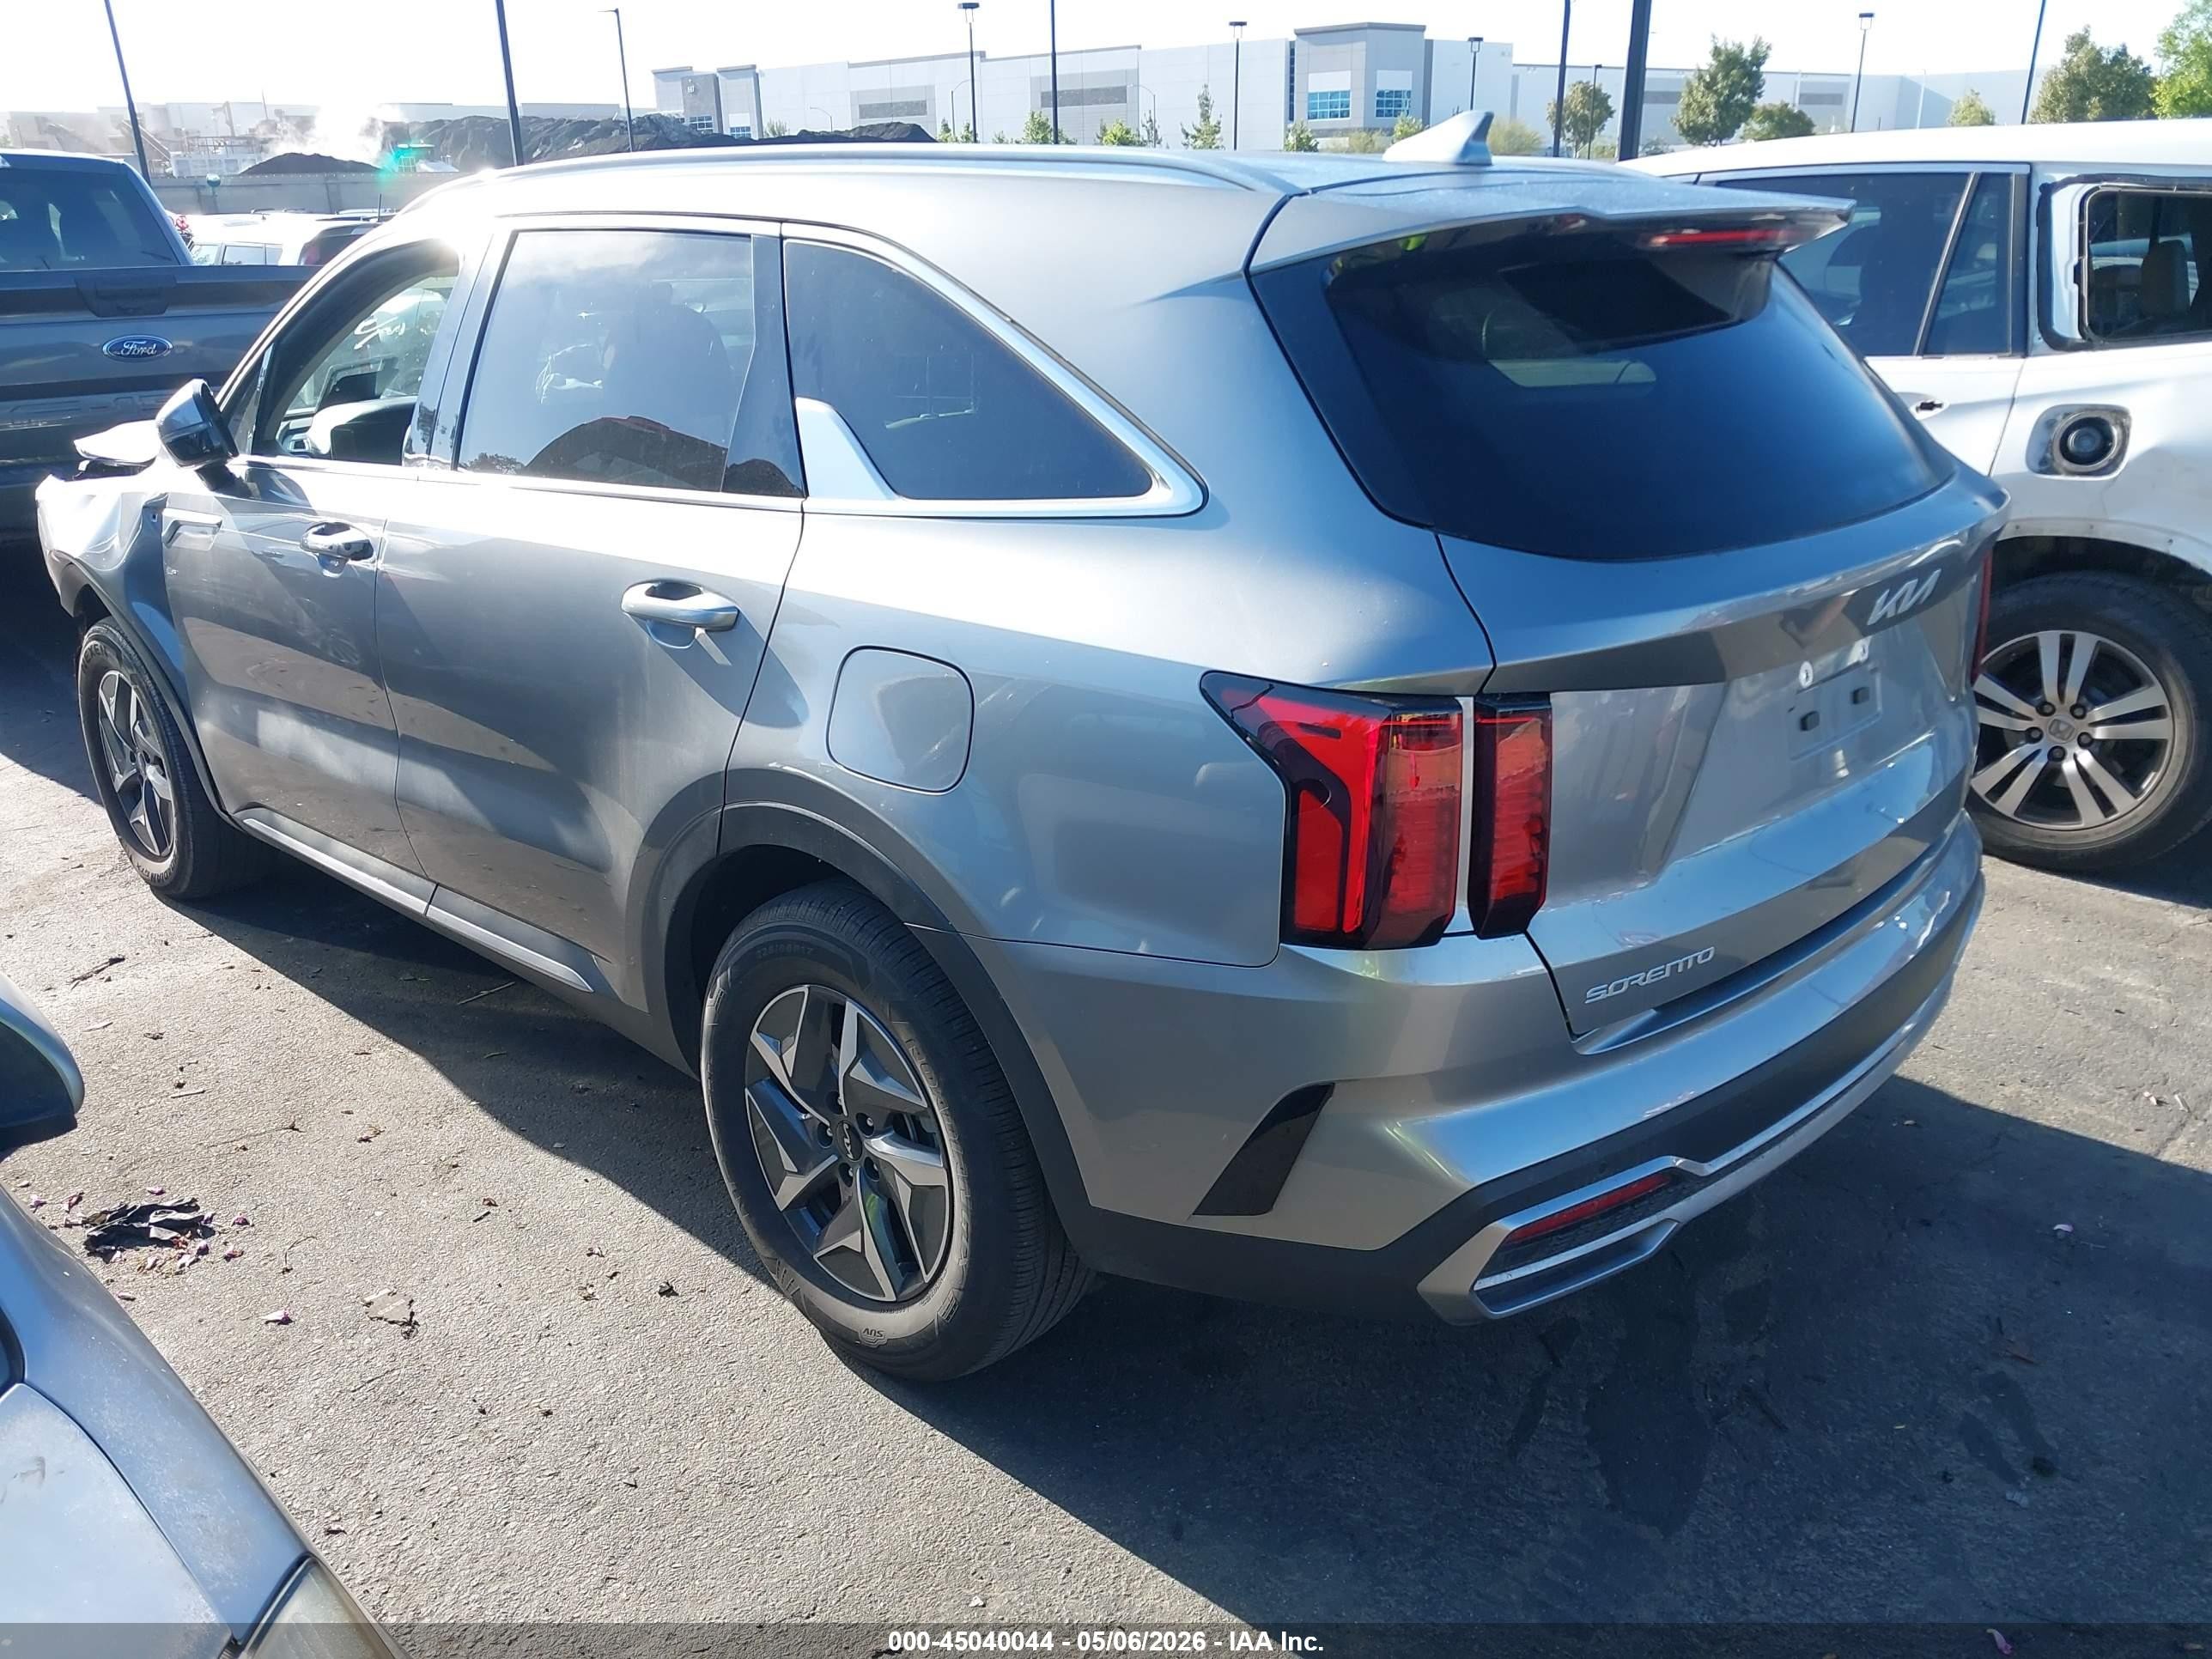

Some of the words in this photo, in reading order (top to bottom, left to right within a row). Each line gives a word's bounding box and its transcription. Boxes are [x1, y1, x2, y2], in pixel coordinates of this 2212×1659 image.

[119, 340, 158, 356] Ford
[1866, 568, 1942, 627] KIA
[1584, 946, 1716, 1005] SORENTO
[862, 1328, 884, 1338] SUV
